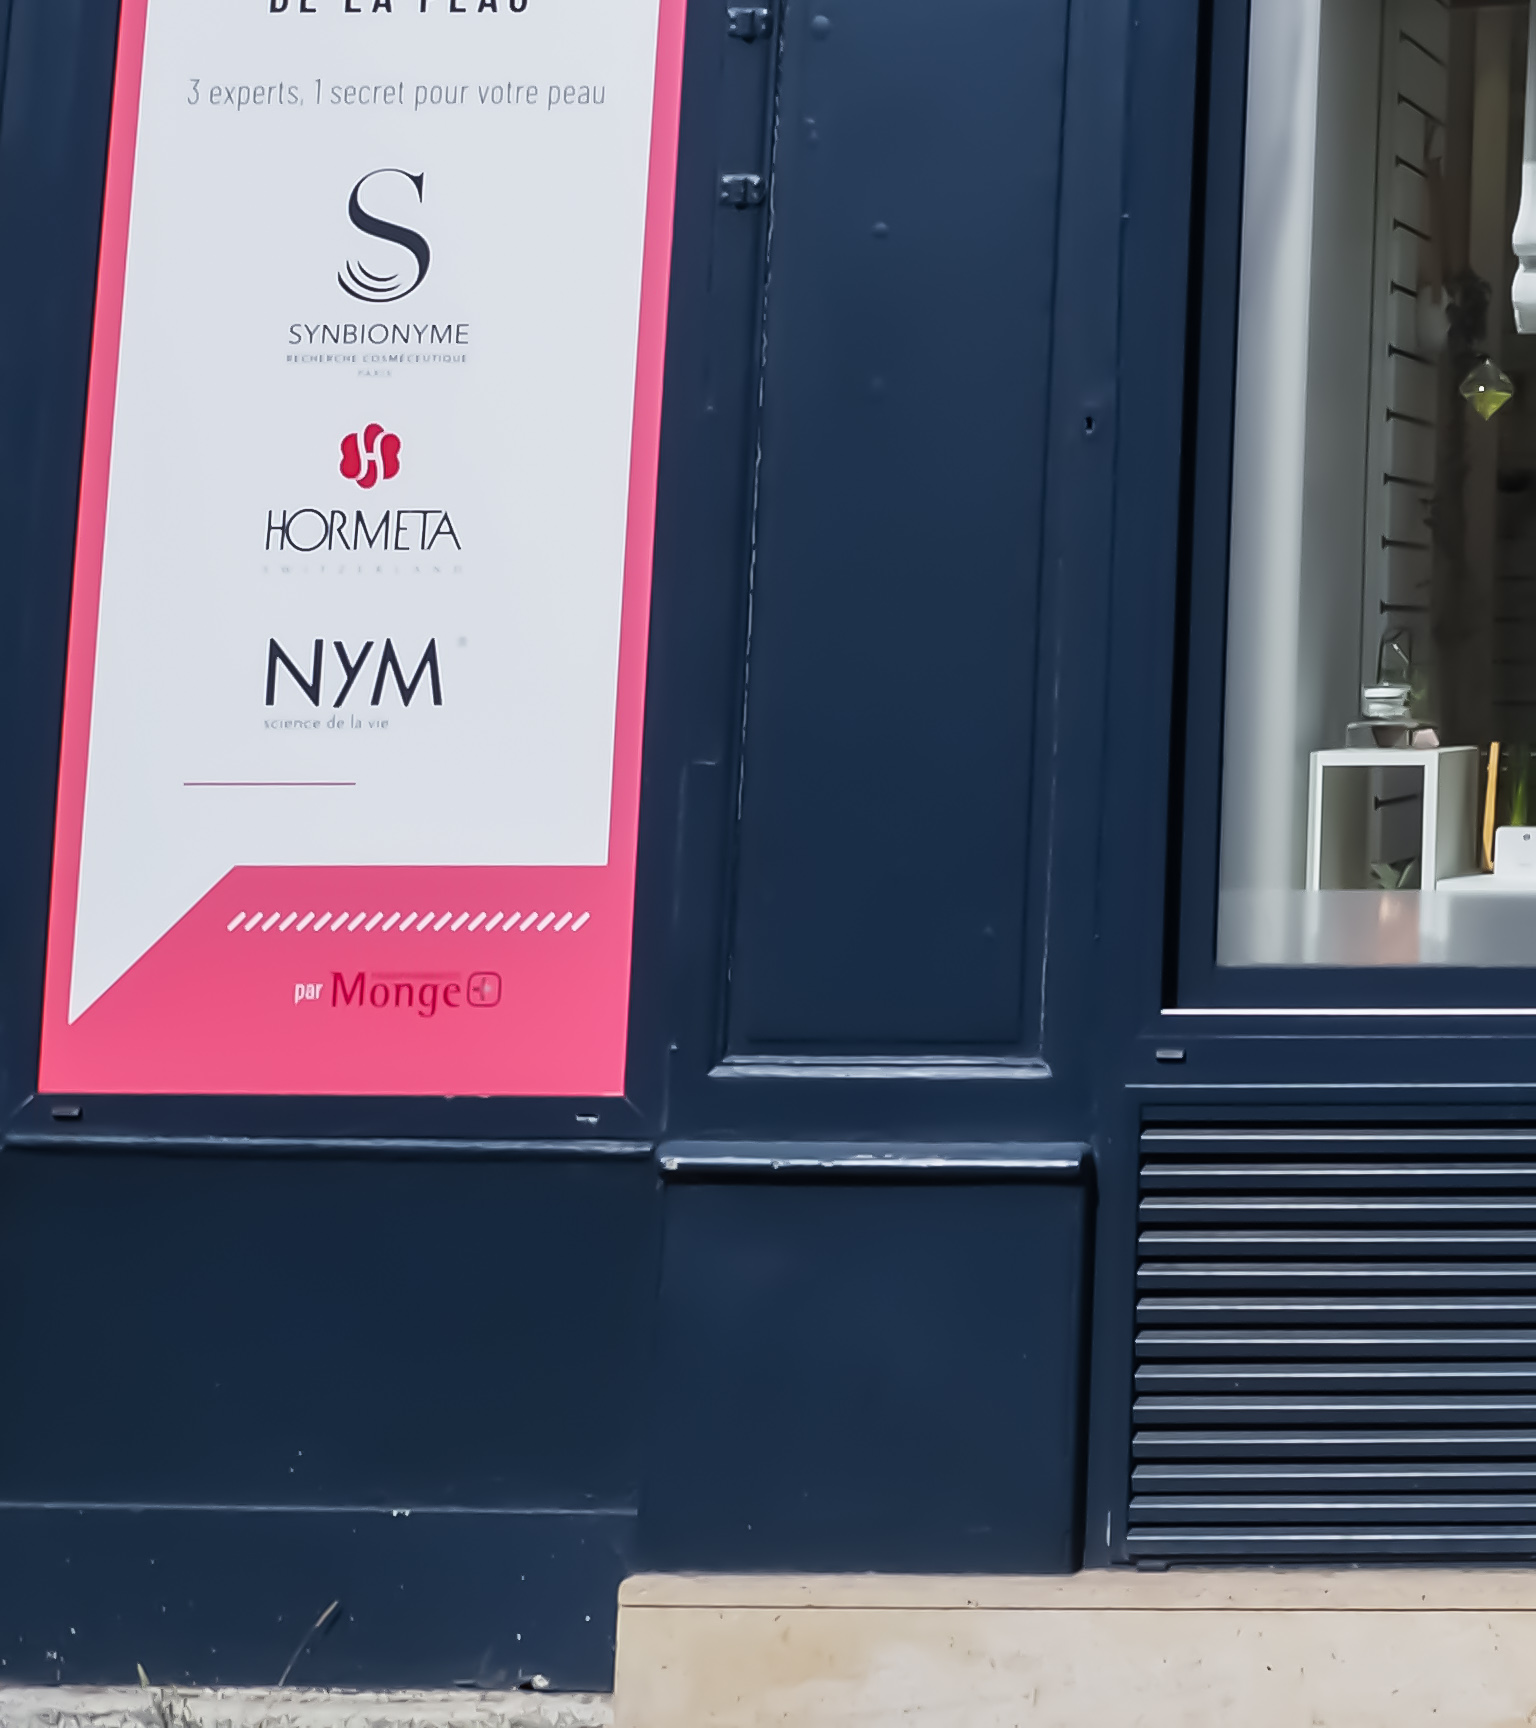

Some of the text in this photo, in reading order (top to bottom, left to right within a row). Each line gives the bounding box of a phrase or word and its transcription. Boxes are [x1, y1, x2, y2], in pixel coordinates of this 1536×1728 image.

[187, 78, 606, 112] 3 experts, 1 secret pour votre peau
[288, 323, 470, 345] SYNBIONYME
[265, 508, 462, 552] HORMETA
[265, 637, 443, 709] NYM
[263, 713, 390, 730] science de la vie
[294, 971, 461, 1018] par Monge
